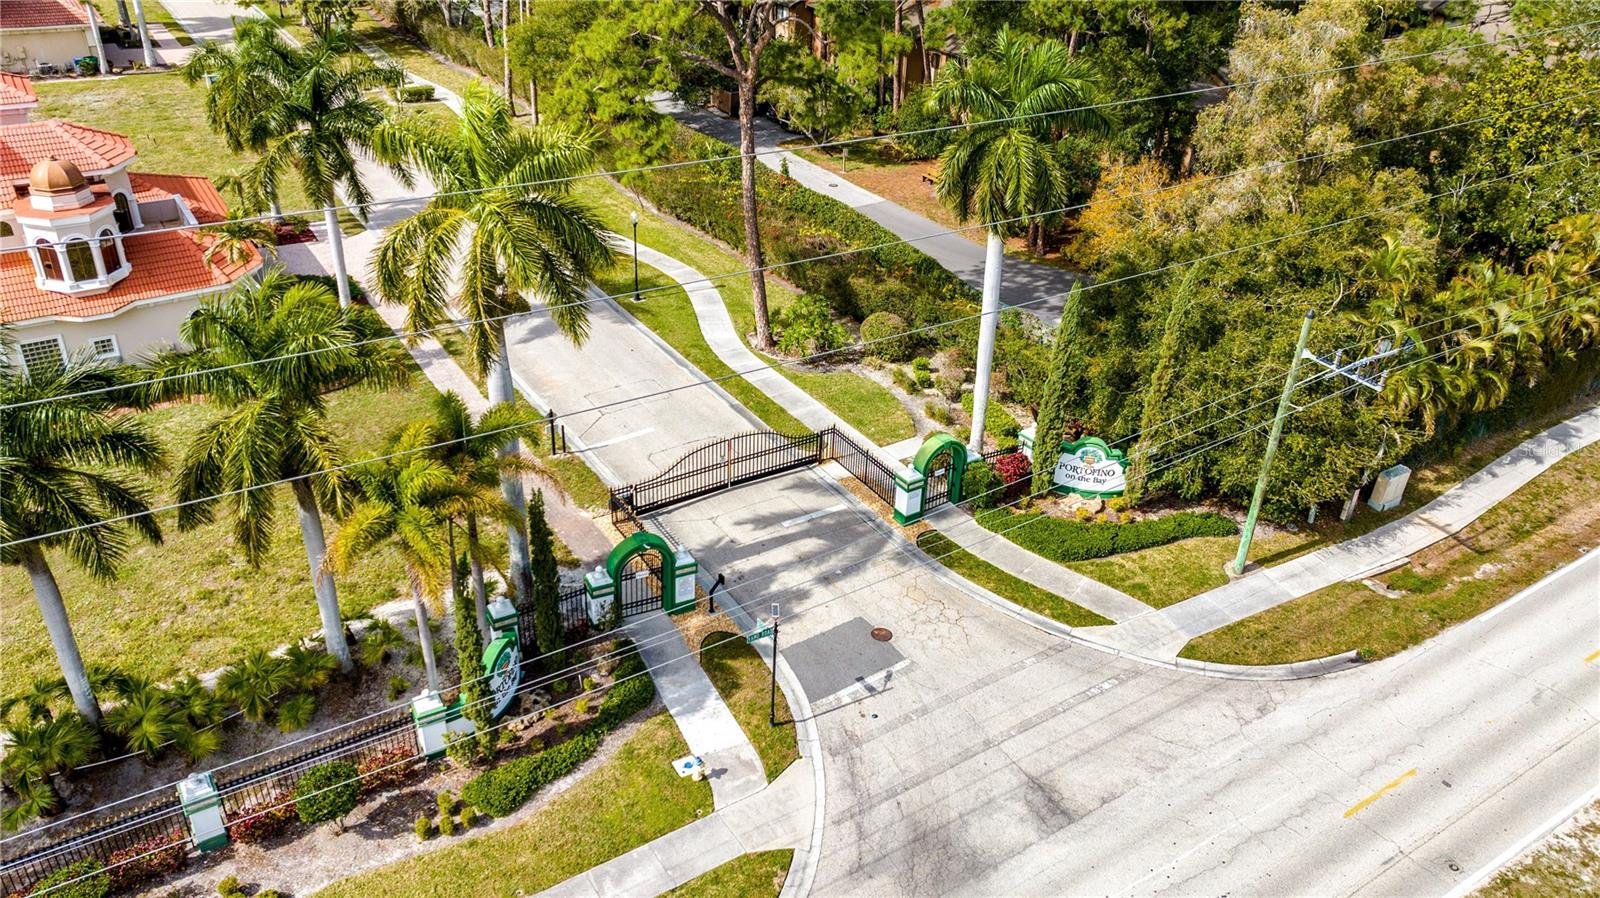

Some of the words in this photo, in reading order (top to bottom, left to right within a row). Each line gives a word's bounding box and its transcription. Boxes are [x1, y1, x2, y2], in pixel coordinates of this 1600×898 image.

[1059, 462, 1115, 477] PORTOFINO
[1065, 473, 1075, 481] on
[1093, 477, 1107, 485] Bay
